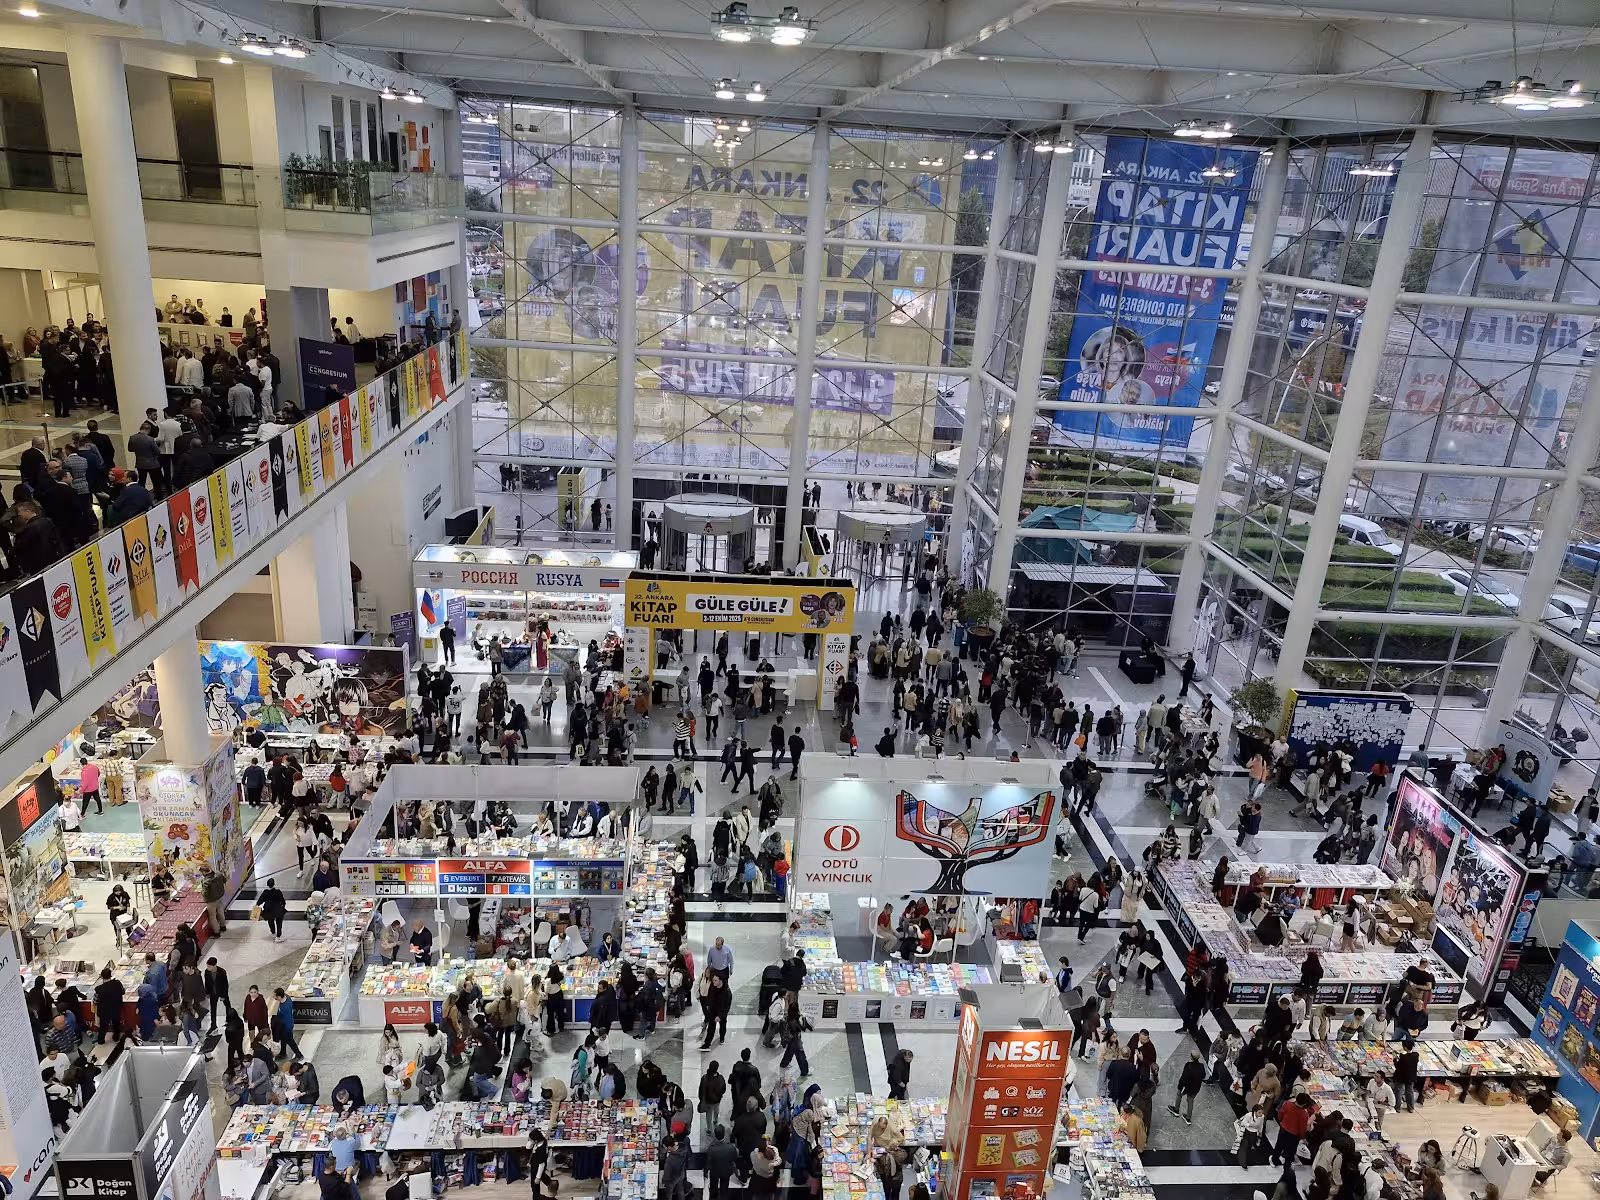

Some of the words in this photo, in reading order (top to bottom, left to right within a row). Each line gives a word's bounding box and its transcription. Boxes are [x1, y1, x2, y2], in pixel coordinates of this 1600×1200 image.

[85, 551, 99, 597] FUARI
[461, 570, 519, 585] РОССИЯ
[536, 572, 583, 587] RUSYA
[695, 595, 735, 612] GÜLE
[633, 613, 675, 624] FUARI
[463, 861, 507, 870] ALFA
[821, 858, 859, 869] ODTÜ
[805, 873, 873, 883] YAYINCILIK
[391, 1006, 426, 1014] ALFA
[180, 1094, 199, 1128] Doğan
[1023, 1105, 1044, 1114] SÖZ
[155, 1139, 174, 1172] Doğan
[157, 1154, 172, 1182] Kitap
[97, 1179, 132, 1188] Doğan
[98, 1188, 127, 1197] Kitap
